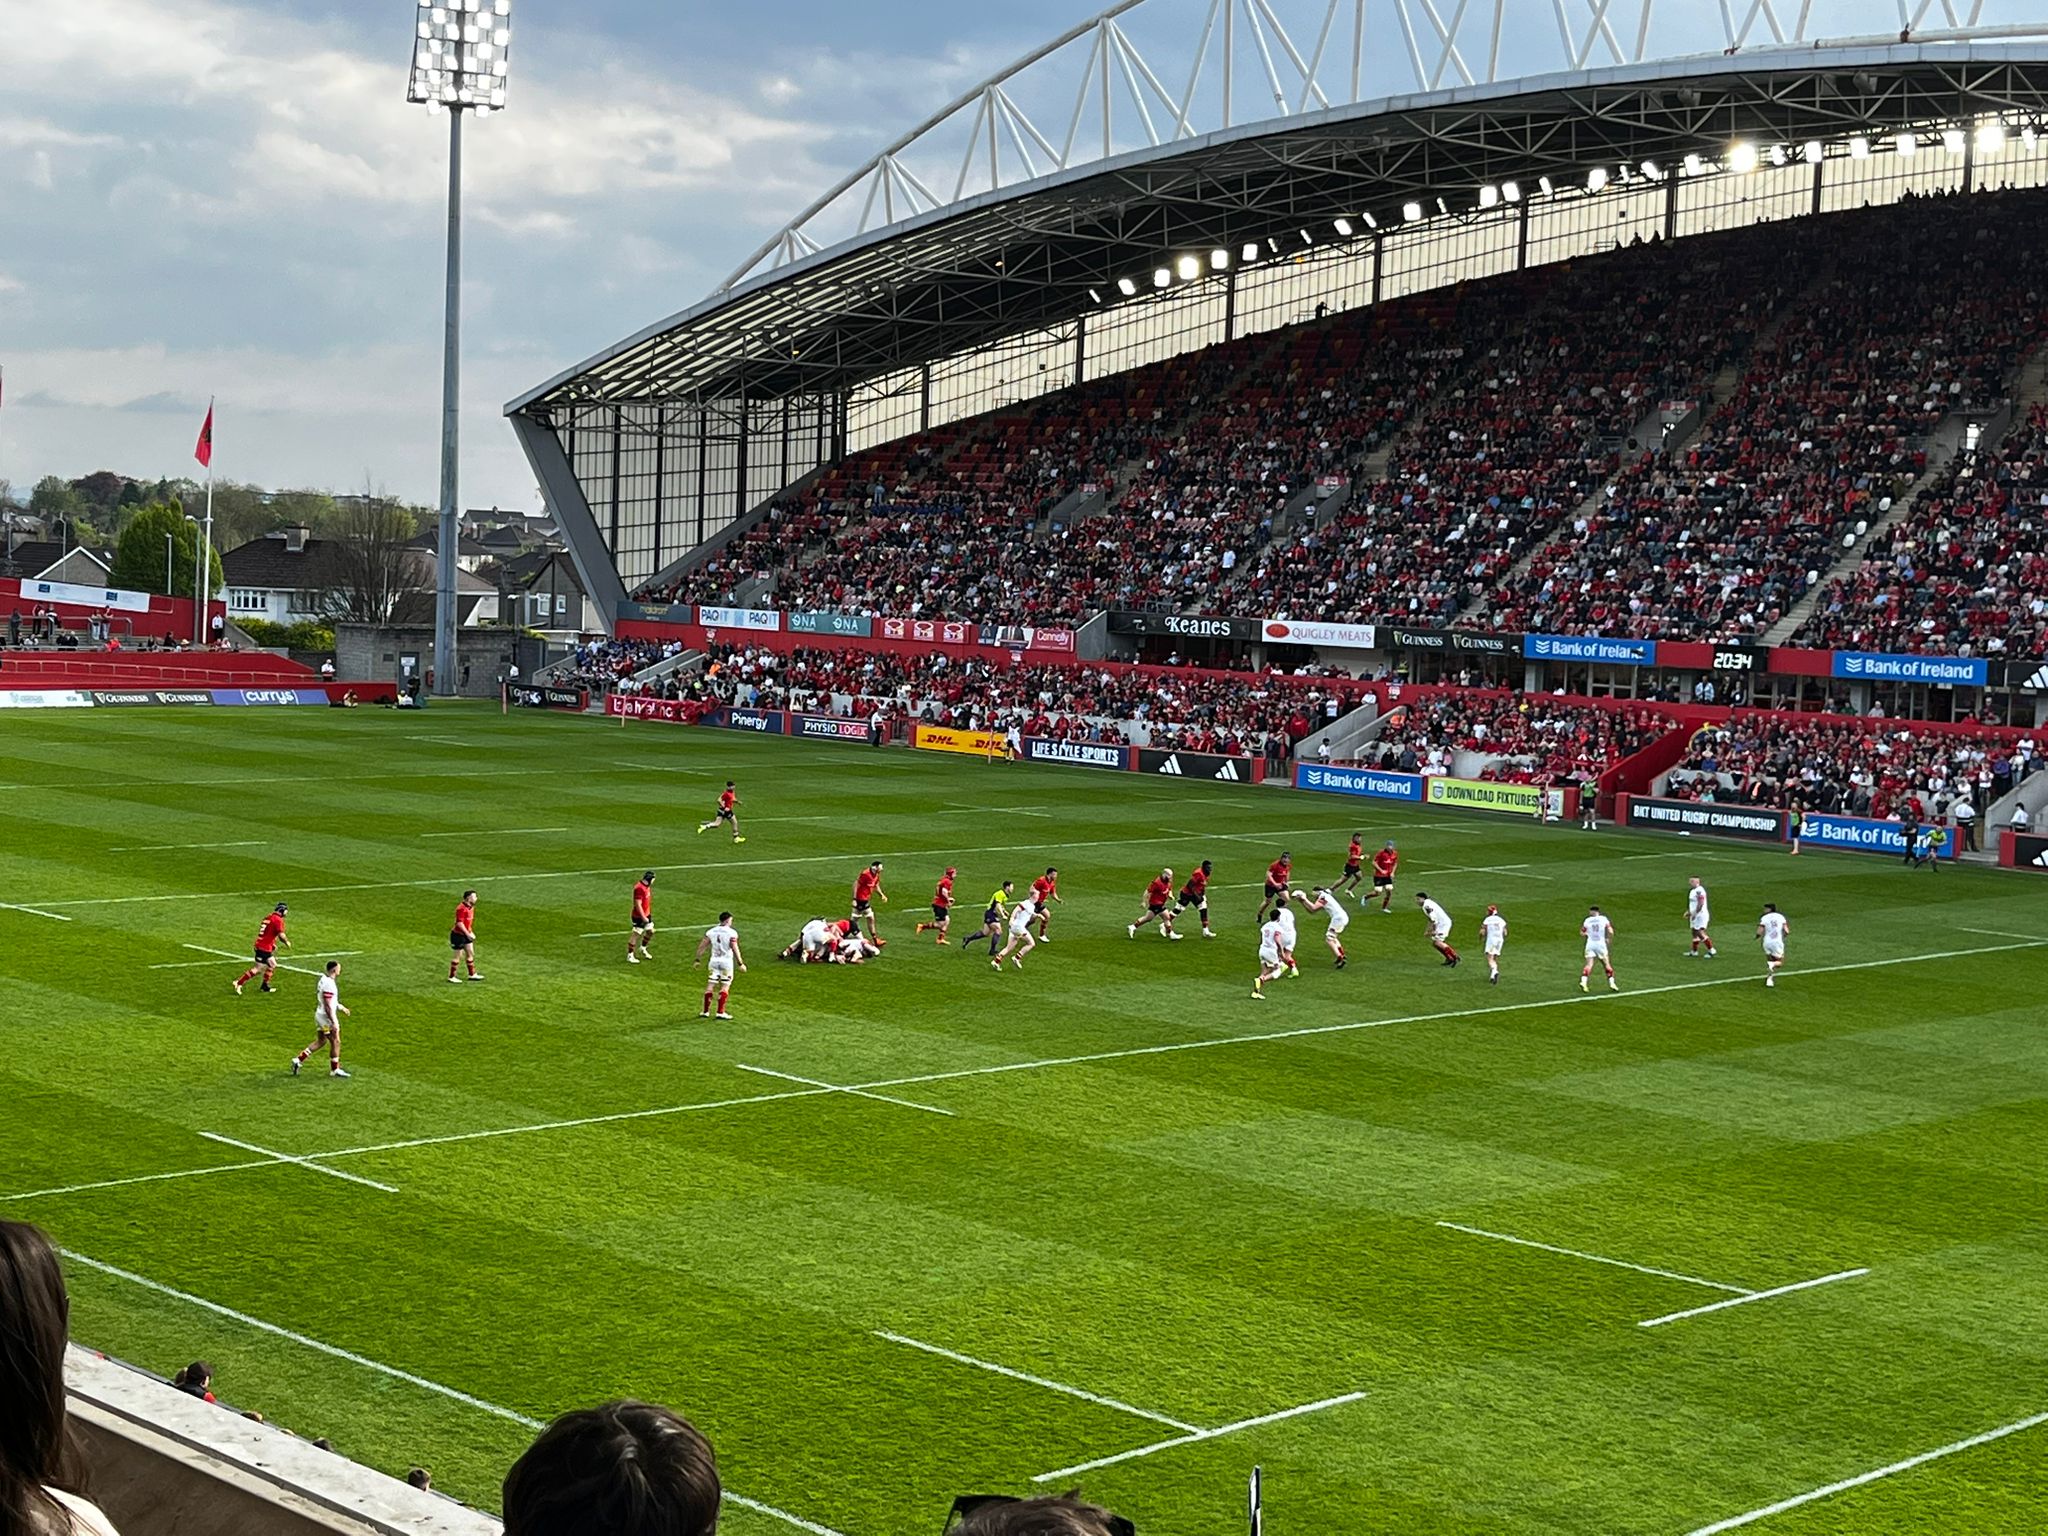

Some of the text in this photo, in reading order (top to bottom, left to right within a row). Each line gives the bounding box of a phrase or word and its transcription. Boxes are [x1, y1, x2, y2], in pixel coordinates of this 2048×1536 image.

[1165, 616, 1231, 636] Keanes
[1292, 627, 1372, 642] QUIGLEY MEATS
[1402, 633, 1443, 647] GUINNESS
[1461, 637, 1504, 650] GUINNESS
[1552, 641, 1582, 656] Bank
[1583, 643, 1598, 657] of
[1865, 659, 1973, 679] Bank of Ireland
[245, 691, 294, 705] currys
[731, 712, 768, 730] Pinergy
[804, 721, 837, 734] PHYSIO
[926, 734, 954, 746] DHL
[1032, 741, 1050, 755] LIFE
[1081, 746, 1119, 762] SPORTS
[1323, 772, 1411, 795] Bank of Ireland
[1447, 786, 1537, 807] DOWNLOAD FIXTURES
[1633, 805, 1776, 832] BKT UNITED RUGBY CHAMPIONSHIP
[1822, 823, 1860, 842] Bank
[1862, 827, 1880, 844] of
